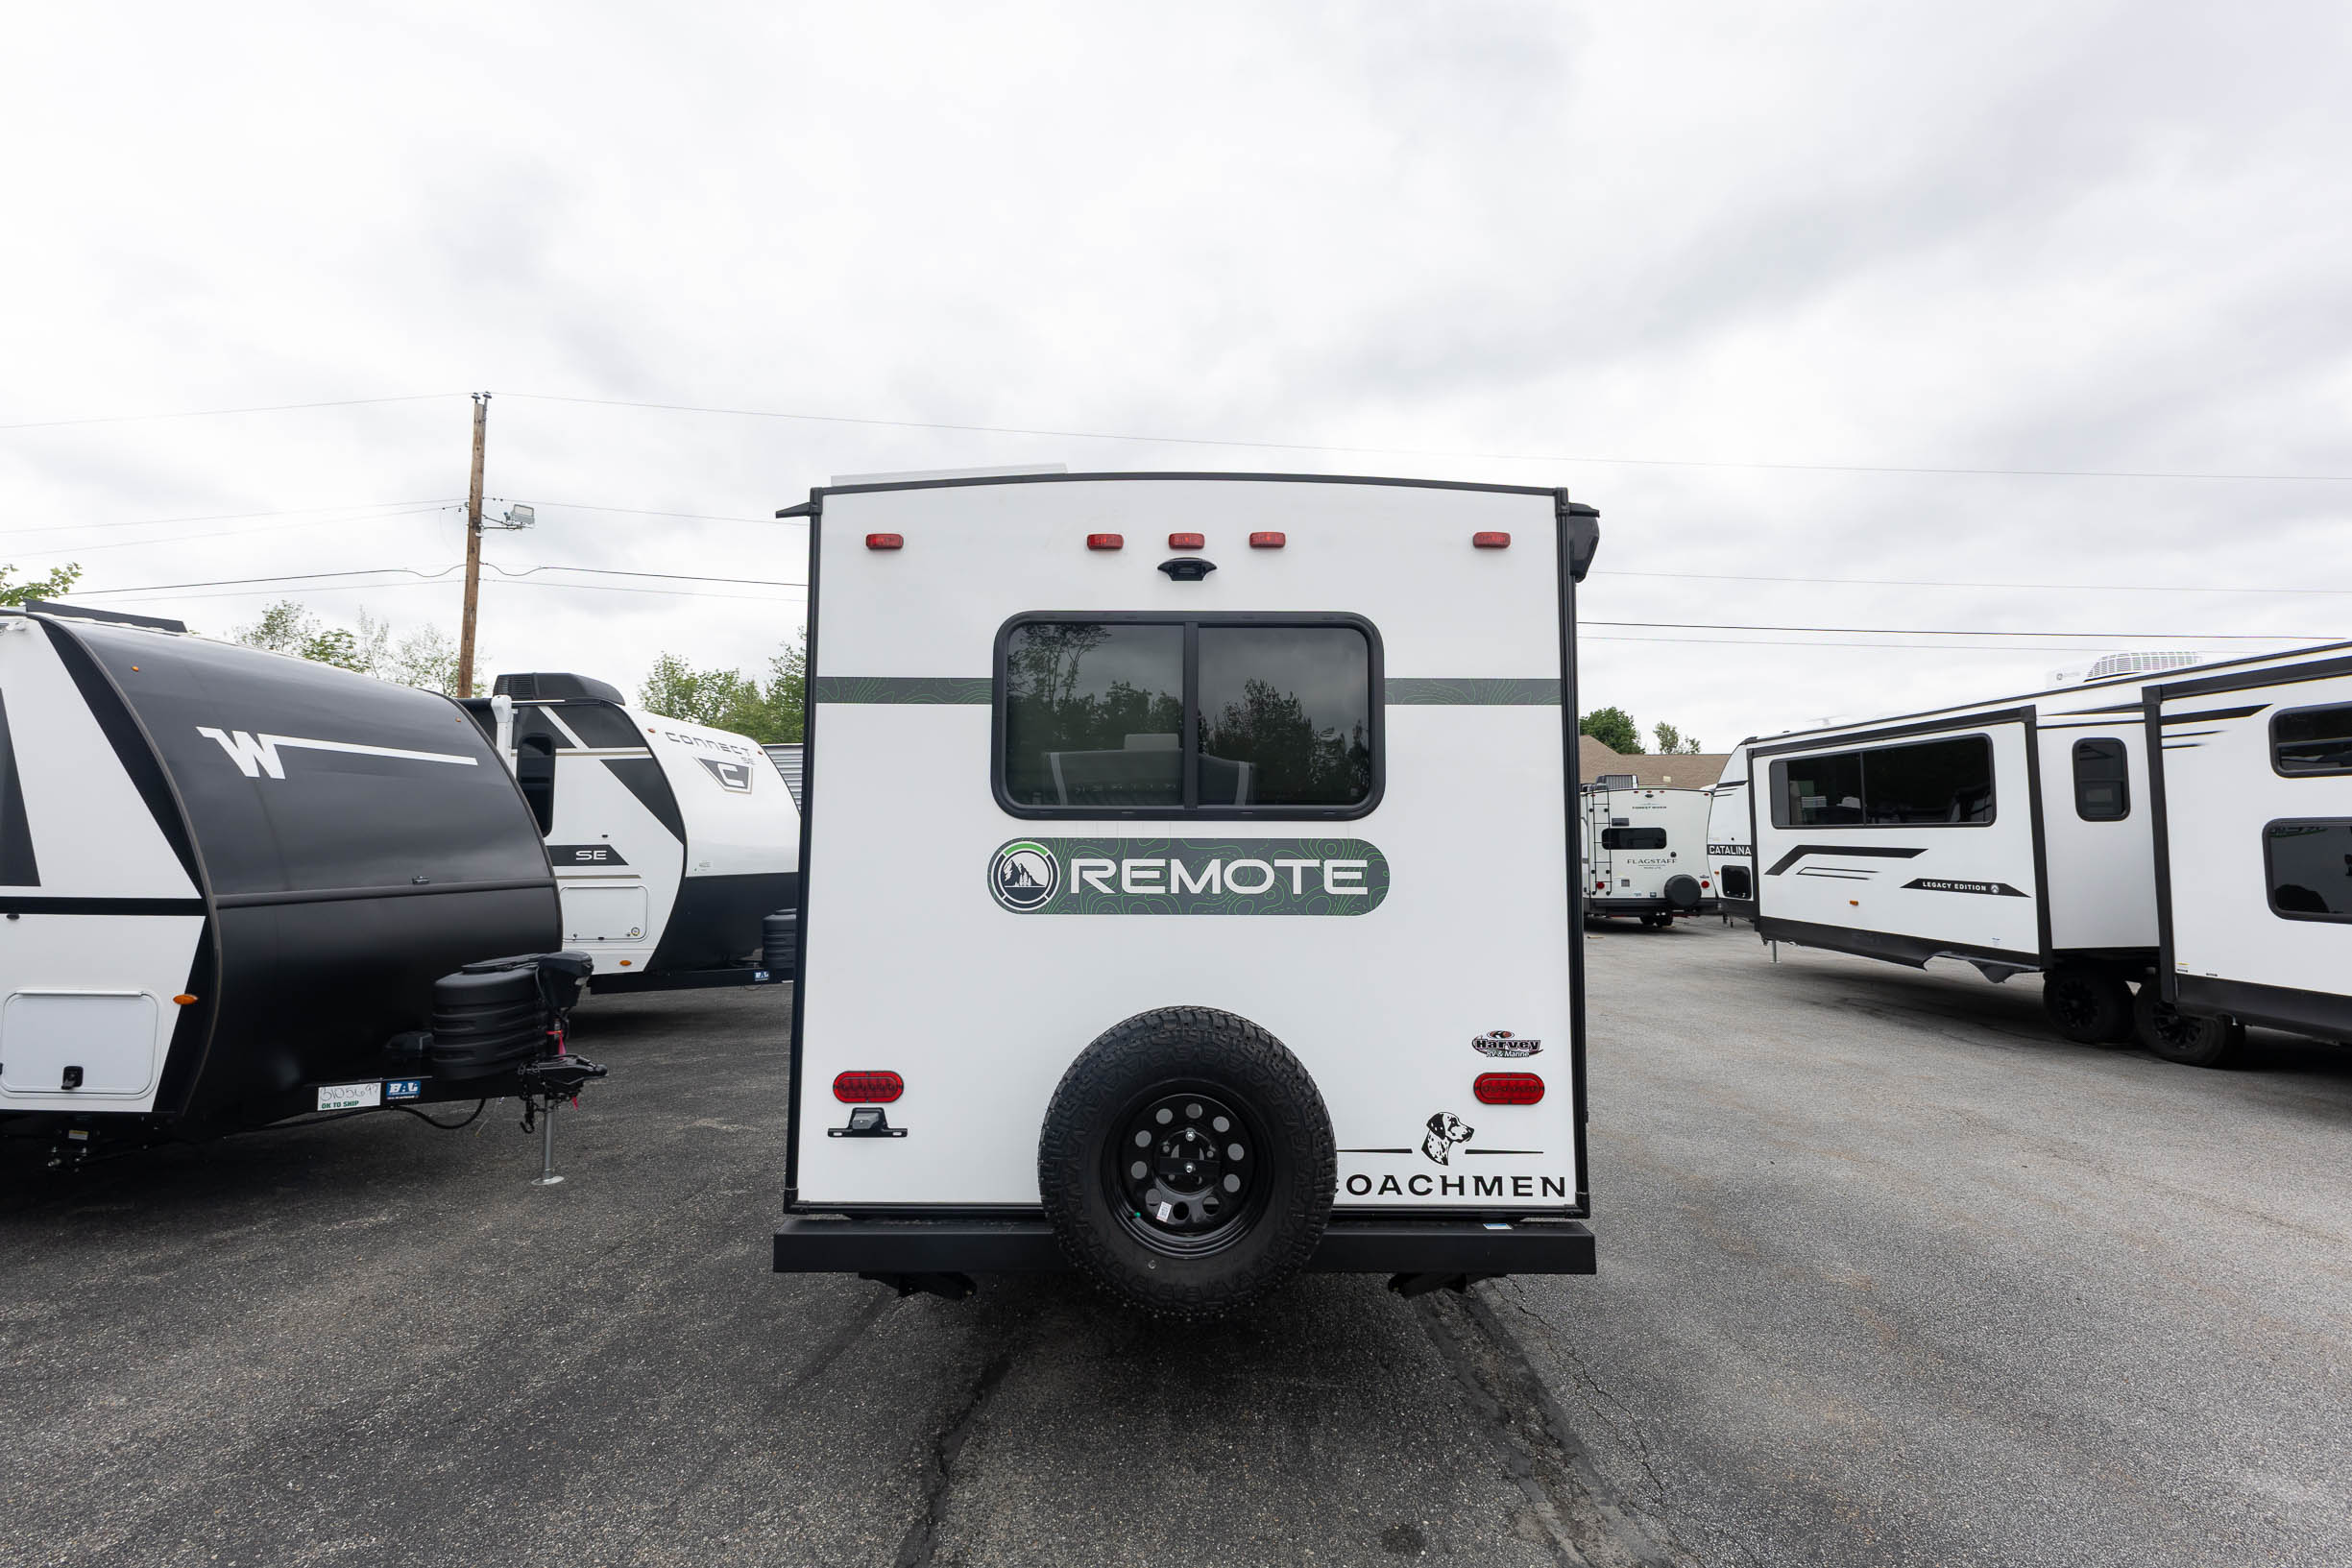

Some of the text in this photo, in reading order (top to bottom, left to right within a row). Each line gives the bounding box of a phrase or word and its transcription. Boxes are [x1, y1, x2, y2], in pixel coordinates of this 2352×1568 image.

[665, 732, 749, 756] CONNECT
[575, 850, 608, 860] SE
[1709, 845, 1752, 856] CATALINA
[1070, 858, 1369, 895] REMOTE
[1475, 1039, 1540, 1051] Harvey
[1335, 1174, 1565, 1197] OACHMEN
